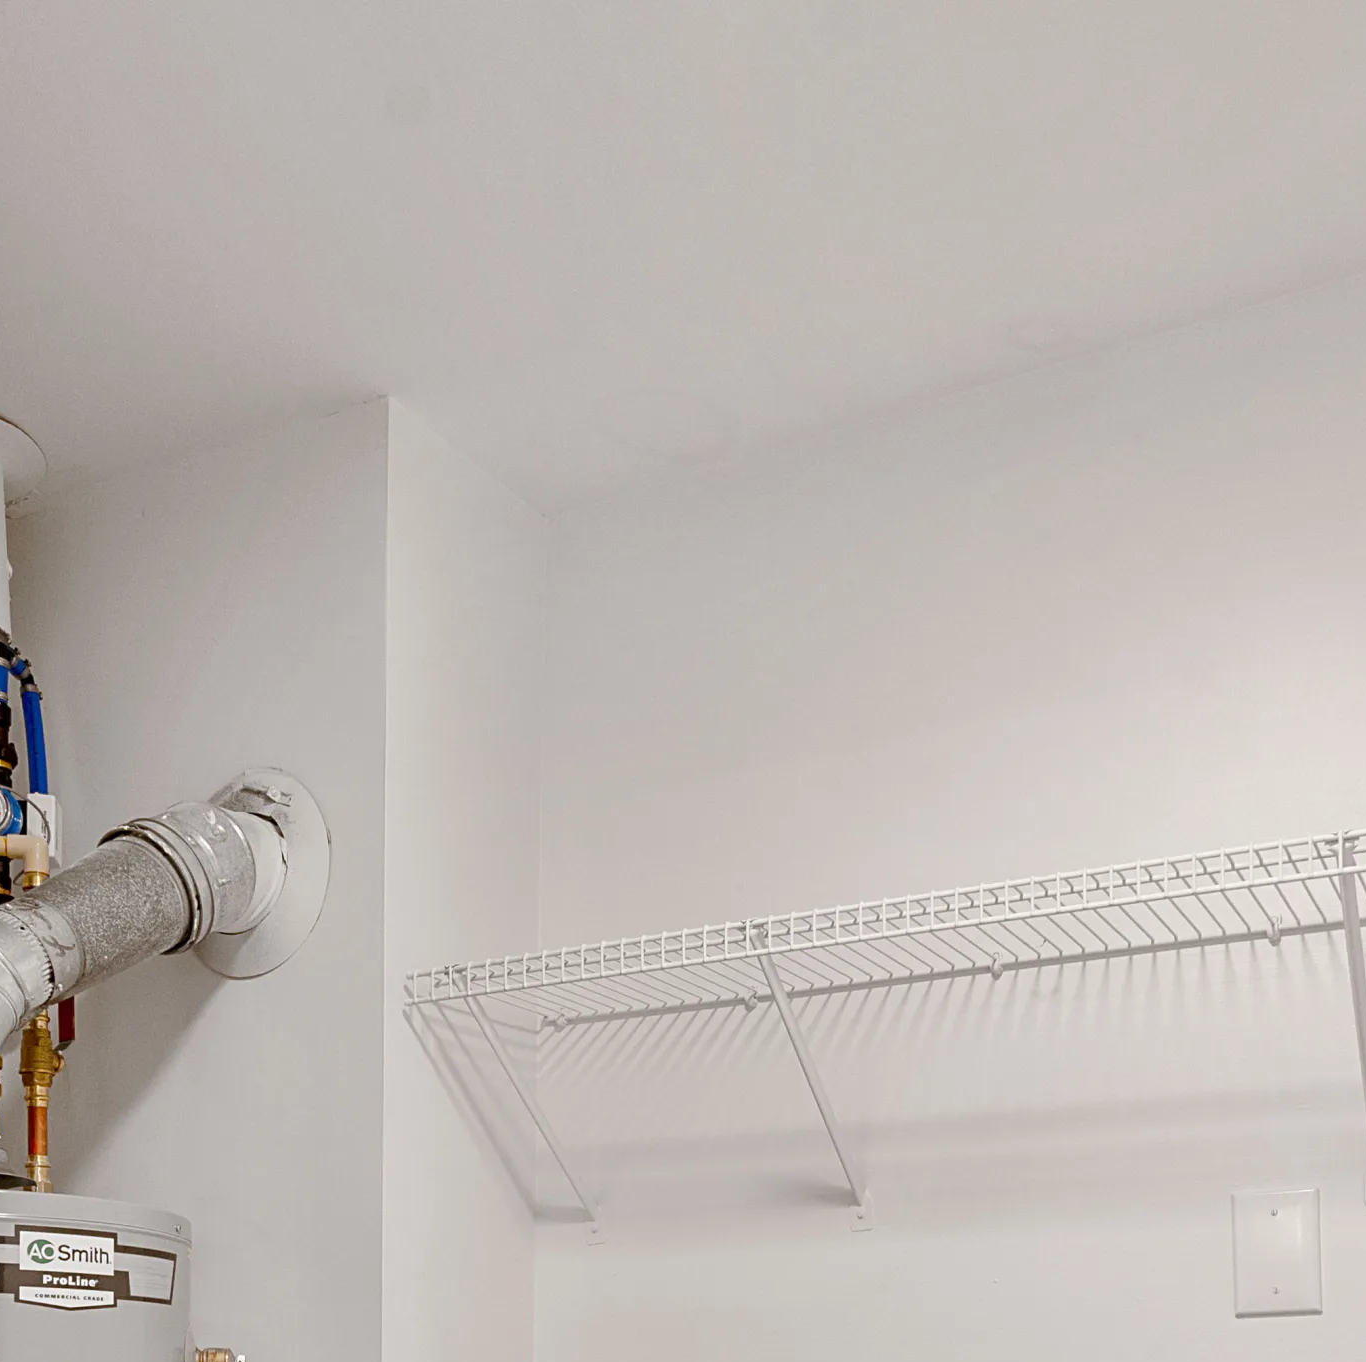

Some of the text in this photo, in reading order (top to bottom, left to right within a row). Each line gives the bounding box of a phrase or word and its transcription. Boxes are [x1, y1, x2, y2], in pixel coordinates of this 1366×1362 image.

[28, 1241, 110, 1265] AO Smith
[42, 1275, 96, 1288] ProLine
[34, 1293, 81, 1301] COMMERCIAL
